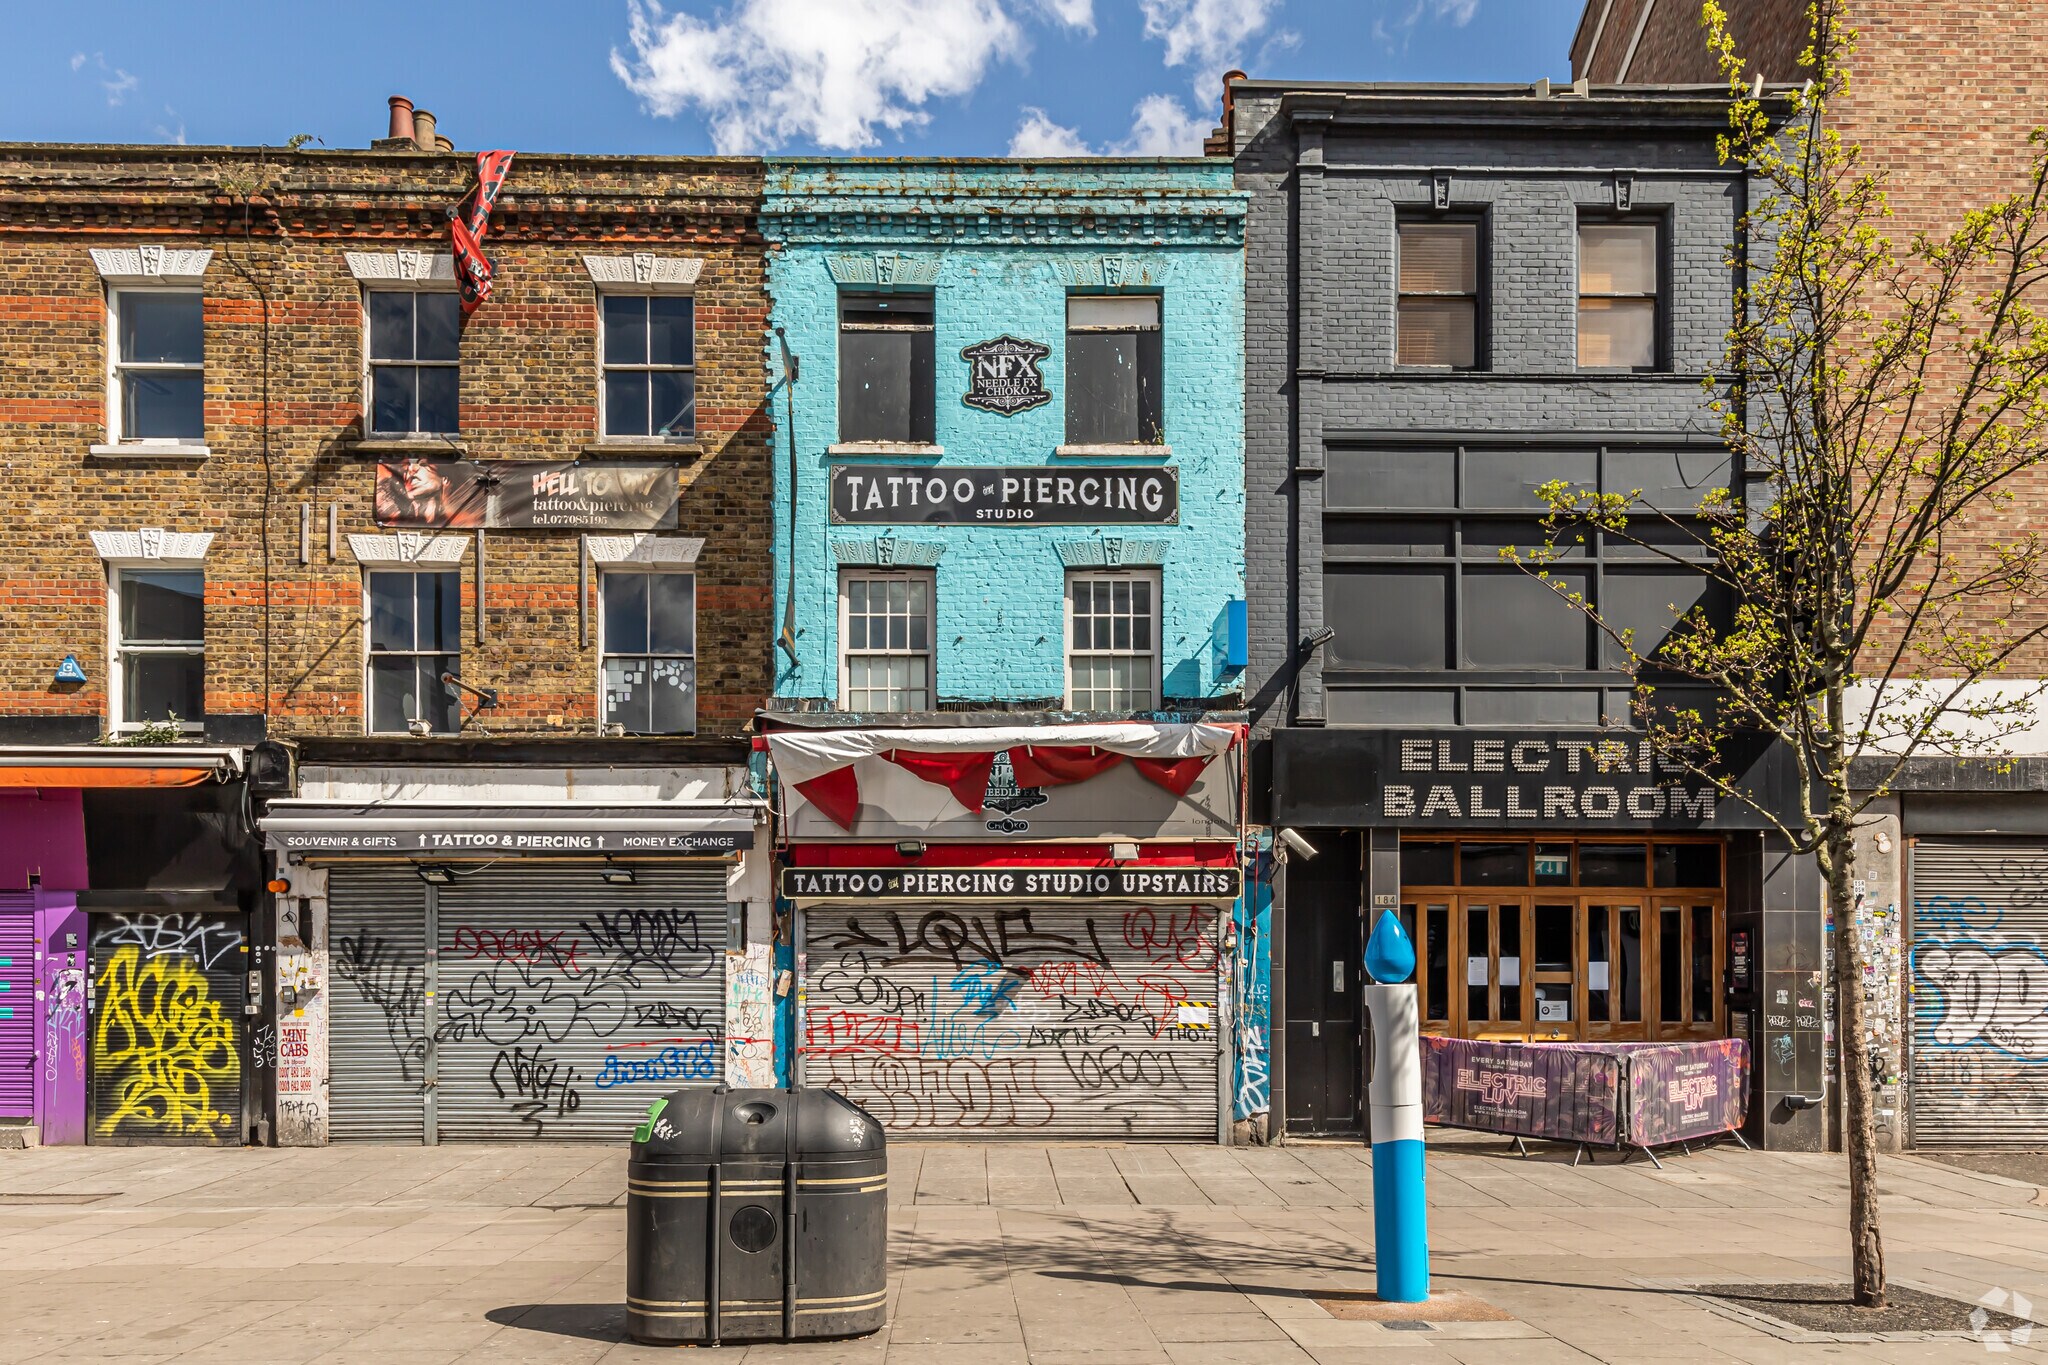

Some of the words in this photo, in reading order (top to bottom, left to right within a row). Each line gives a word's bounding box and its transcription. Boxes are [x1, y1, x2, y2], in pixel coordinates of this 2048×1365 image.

[977, 354, 1038, 379] NFX
[977, 378, 1021, 388] NEEDLE
[1023, 377, 1038, 386] FX
[985, 386, 1030, 396] CHIOKO
[532, 470, 579, 496] HELL
[583, 472, 612, 496] TO
[846, 476, 975, 512] TATTOO
[1001, 477, 1164, 512] PIERCING
[976, 509, 1034, 519] STUDIO
[1401, 739, 1696, 773] ELECTRIC
[1383, 785, 1716, 819] BALLROOM
[287, 836, 349, 847] SOUVENIR
[351, 836, 360, 847] &
[362, 836, 397, 847] GIFTS
[432, 834, 498, 847] TATTOO
[501, 834, 513, 847] &
[516, 835, 592, 848] PIERCING
[623, 837, 666, 847] MONEY
[669, 837, 734, 848] EXCHANGE
[794, 874, 884, 893] TATTOO
[902, 874, 1014, 893] PIERCING
[1025, 874, 1110, 893] STUDIO
[1122, 874, 1229, 893] UPSTAIRS
[1375, 895, 1396, 905] 184
[282, 1028, 307, 1042] MINI
[280, 1043, 309, 1057] CABS
[1471, 1056, 1494, 1065] EVERY
[1496, 1058, 1533, 1068] SATURDAY
[1457, 1068, 1547, 1093] ELECTRIC
[1668, 1075, 1717, 1097] ELECTRIC
[1481, 1087, 1519, 1105] LUV
[1684, 1093, 1704, 1111] LUV
[1498, 1107, 1527, 1115] BALLROOM
